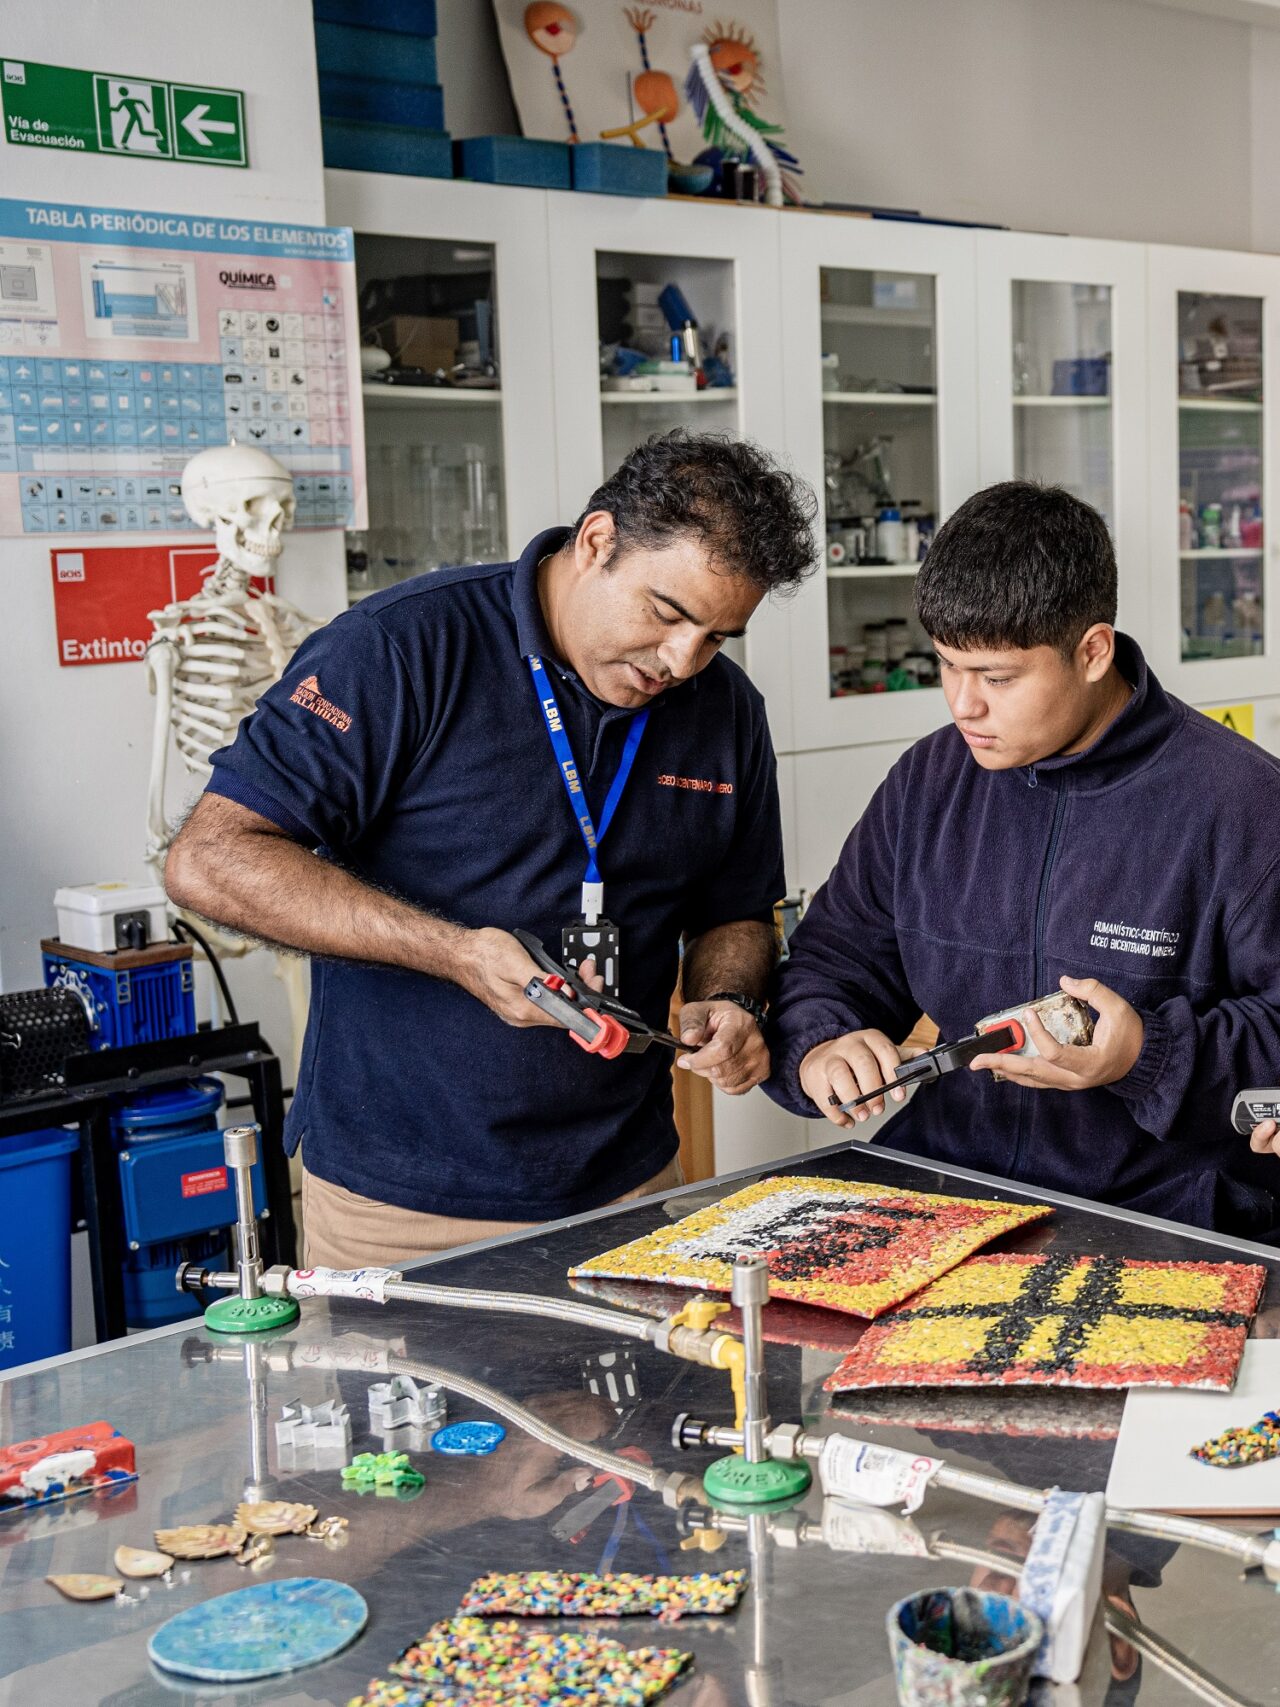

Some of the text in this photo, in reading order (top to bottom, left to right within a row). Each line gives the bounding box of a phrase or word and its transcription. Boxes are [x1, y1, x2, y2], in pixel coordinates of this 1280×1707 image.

[8, 115, 49, 131] Vía de
[10, 129, 85, 149] Evacuación
[26, 207, 348, 249] TABLA PERIÓDICA DE LOS ELEMENTOS
[219, 269, 276, 285] QUÍMICA
[289, 693, 350, 733] OLLAHUASI
[543, 698, 563, 732] LBM
[562, 760, 582, 794] LBM
[677, 776, 712, 792] CENTENARIO
[579, 816, 597, 849] LBM
[1090, 934, 1109, 948] LICEO
[1110, 938, 1151, 956] BICENTENARIO
